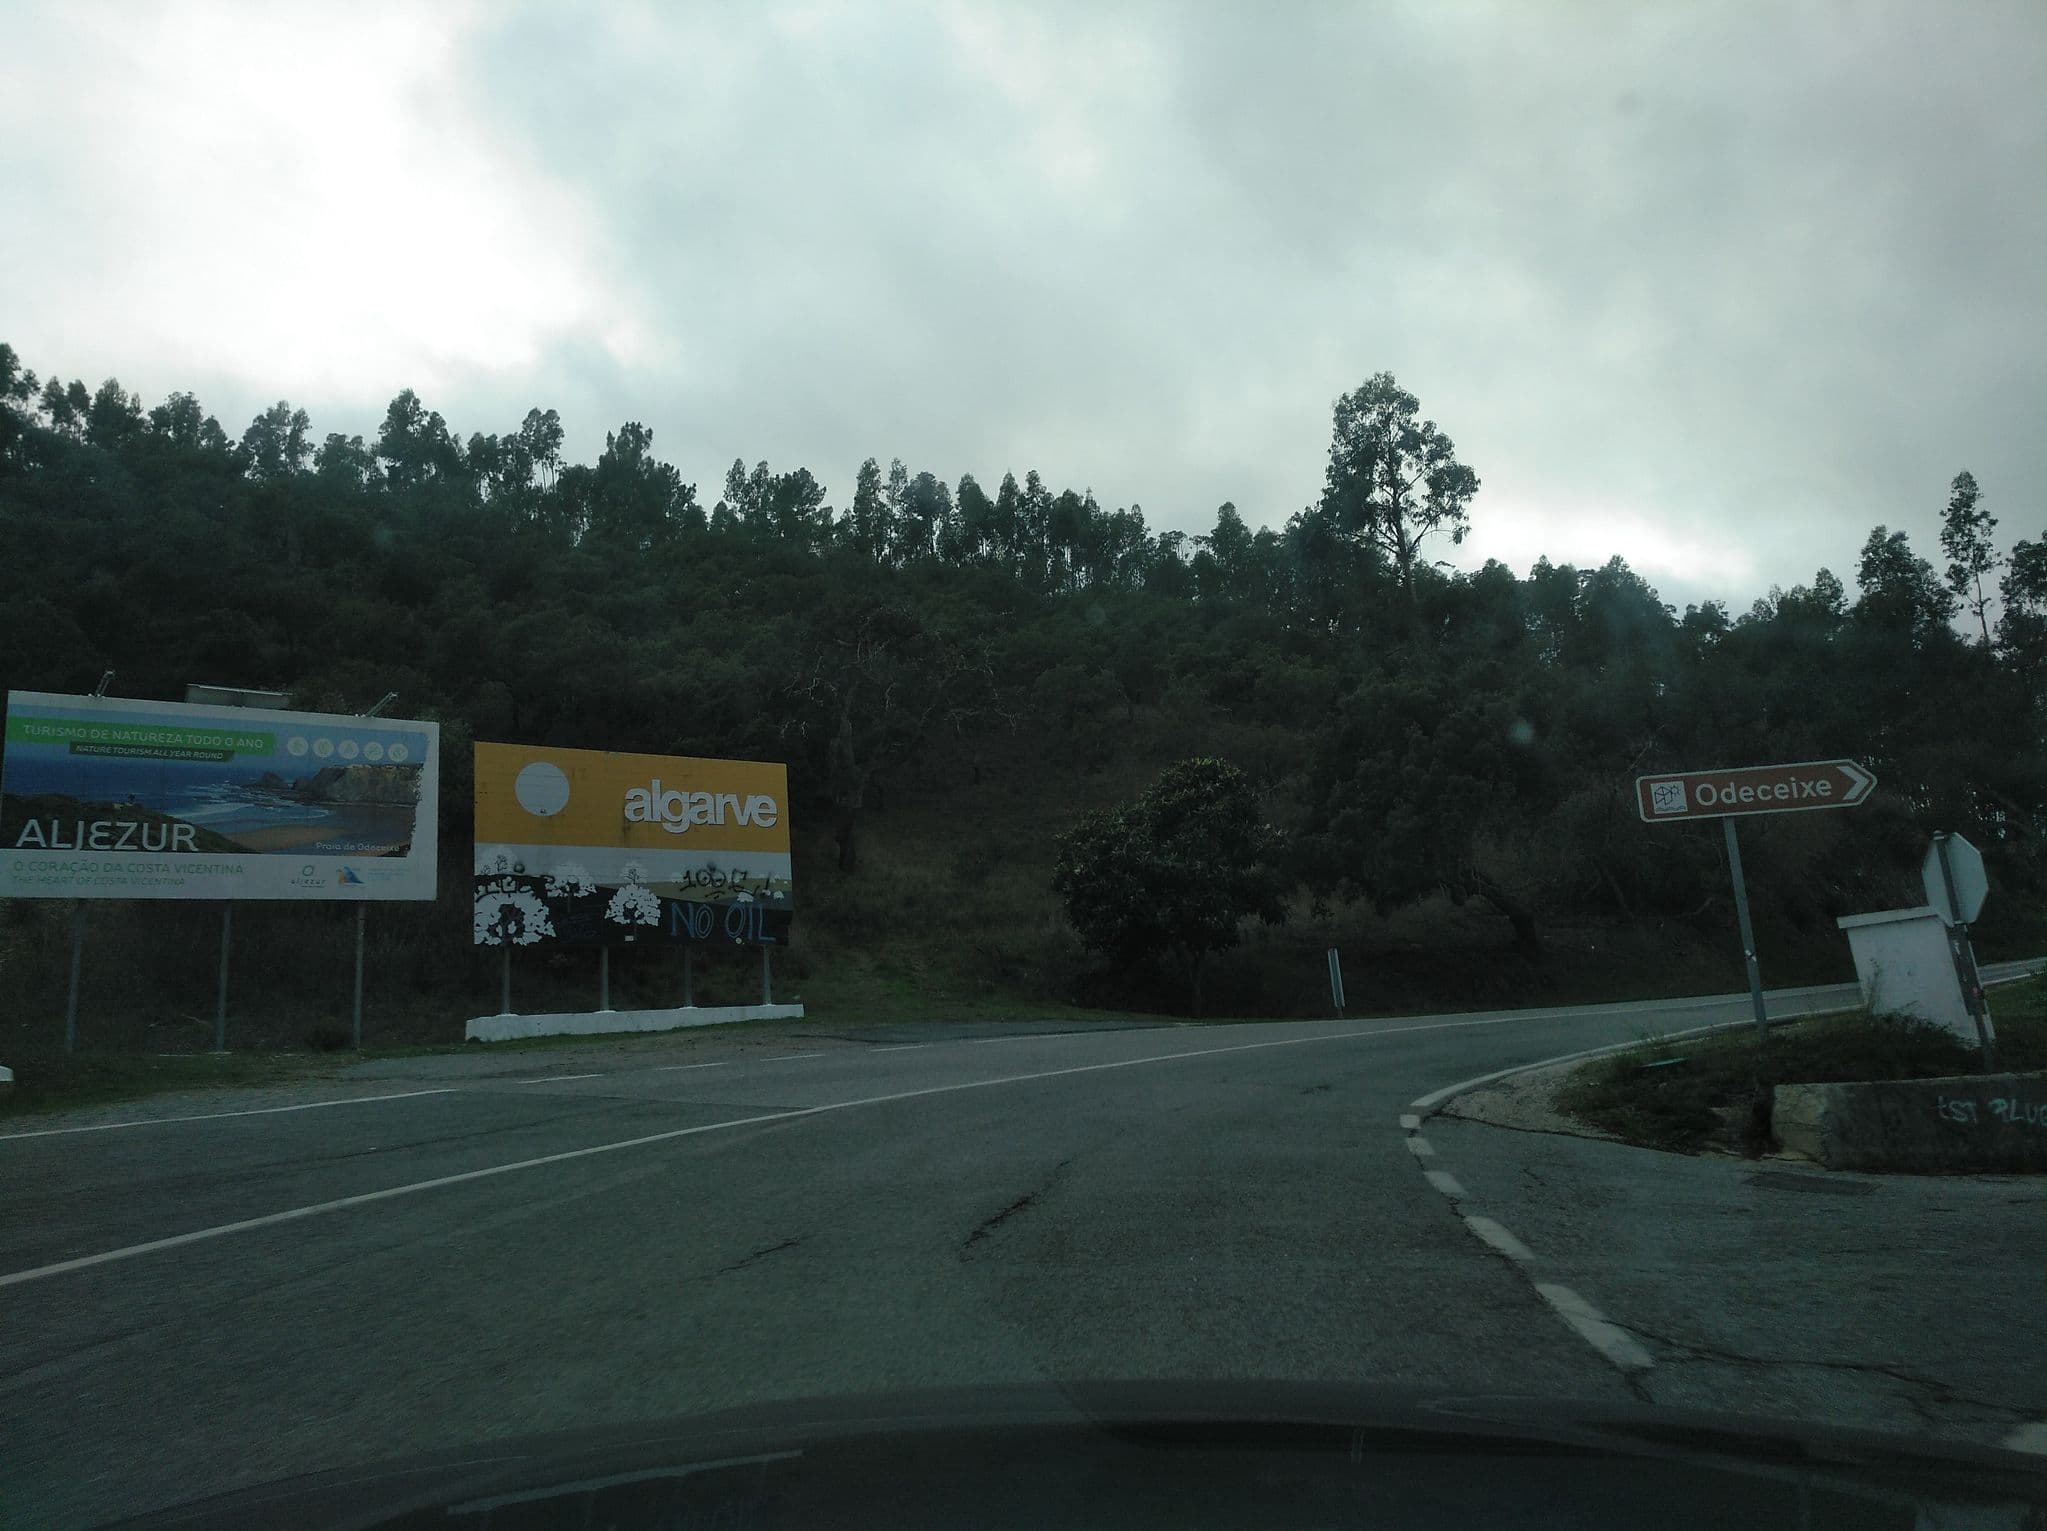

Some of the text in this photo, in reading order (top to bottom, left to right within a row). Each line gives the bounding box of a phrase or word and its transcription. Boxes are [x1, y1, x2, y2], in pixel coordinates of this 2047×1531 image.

[24, 724, 264, 749] TURISMO DE NATUREZA TODO O ANO
[76, 744, 224, 760] NATURE TOURISM ALL YEAR ROUND
[1695, 775, 1833, 807] Odeceixe
[624, 779, 778, 834] algarve
[16, 818, 200, 851] ALJEZUR
[315, 841, 342, 851] Praia
[344, 842, 355, 851] de
[14, 859, 244, 875] O CORAÇÃO DA COSTA VICENTINA
[671, 902, 777, 941] NO OIL
